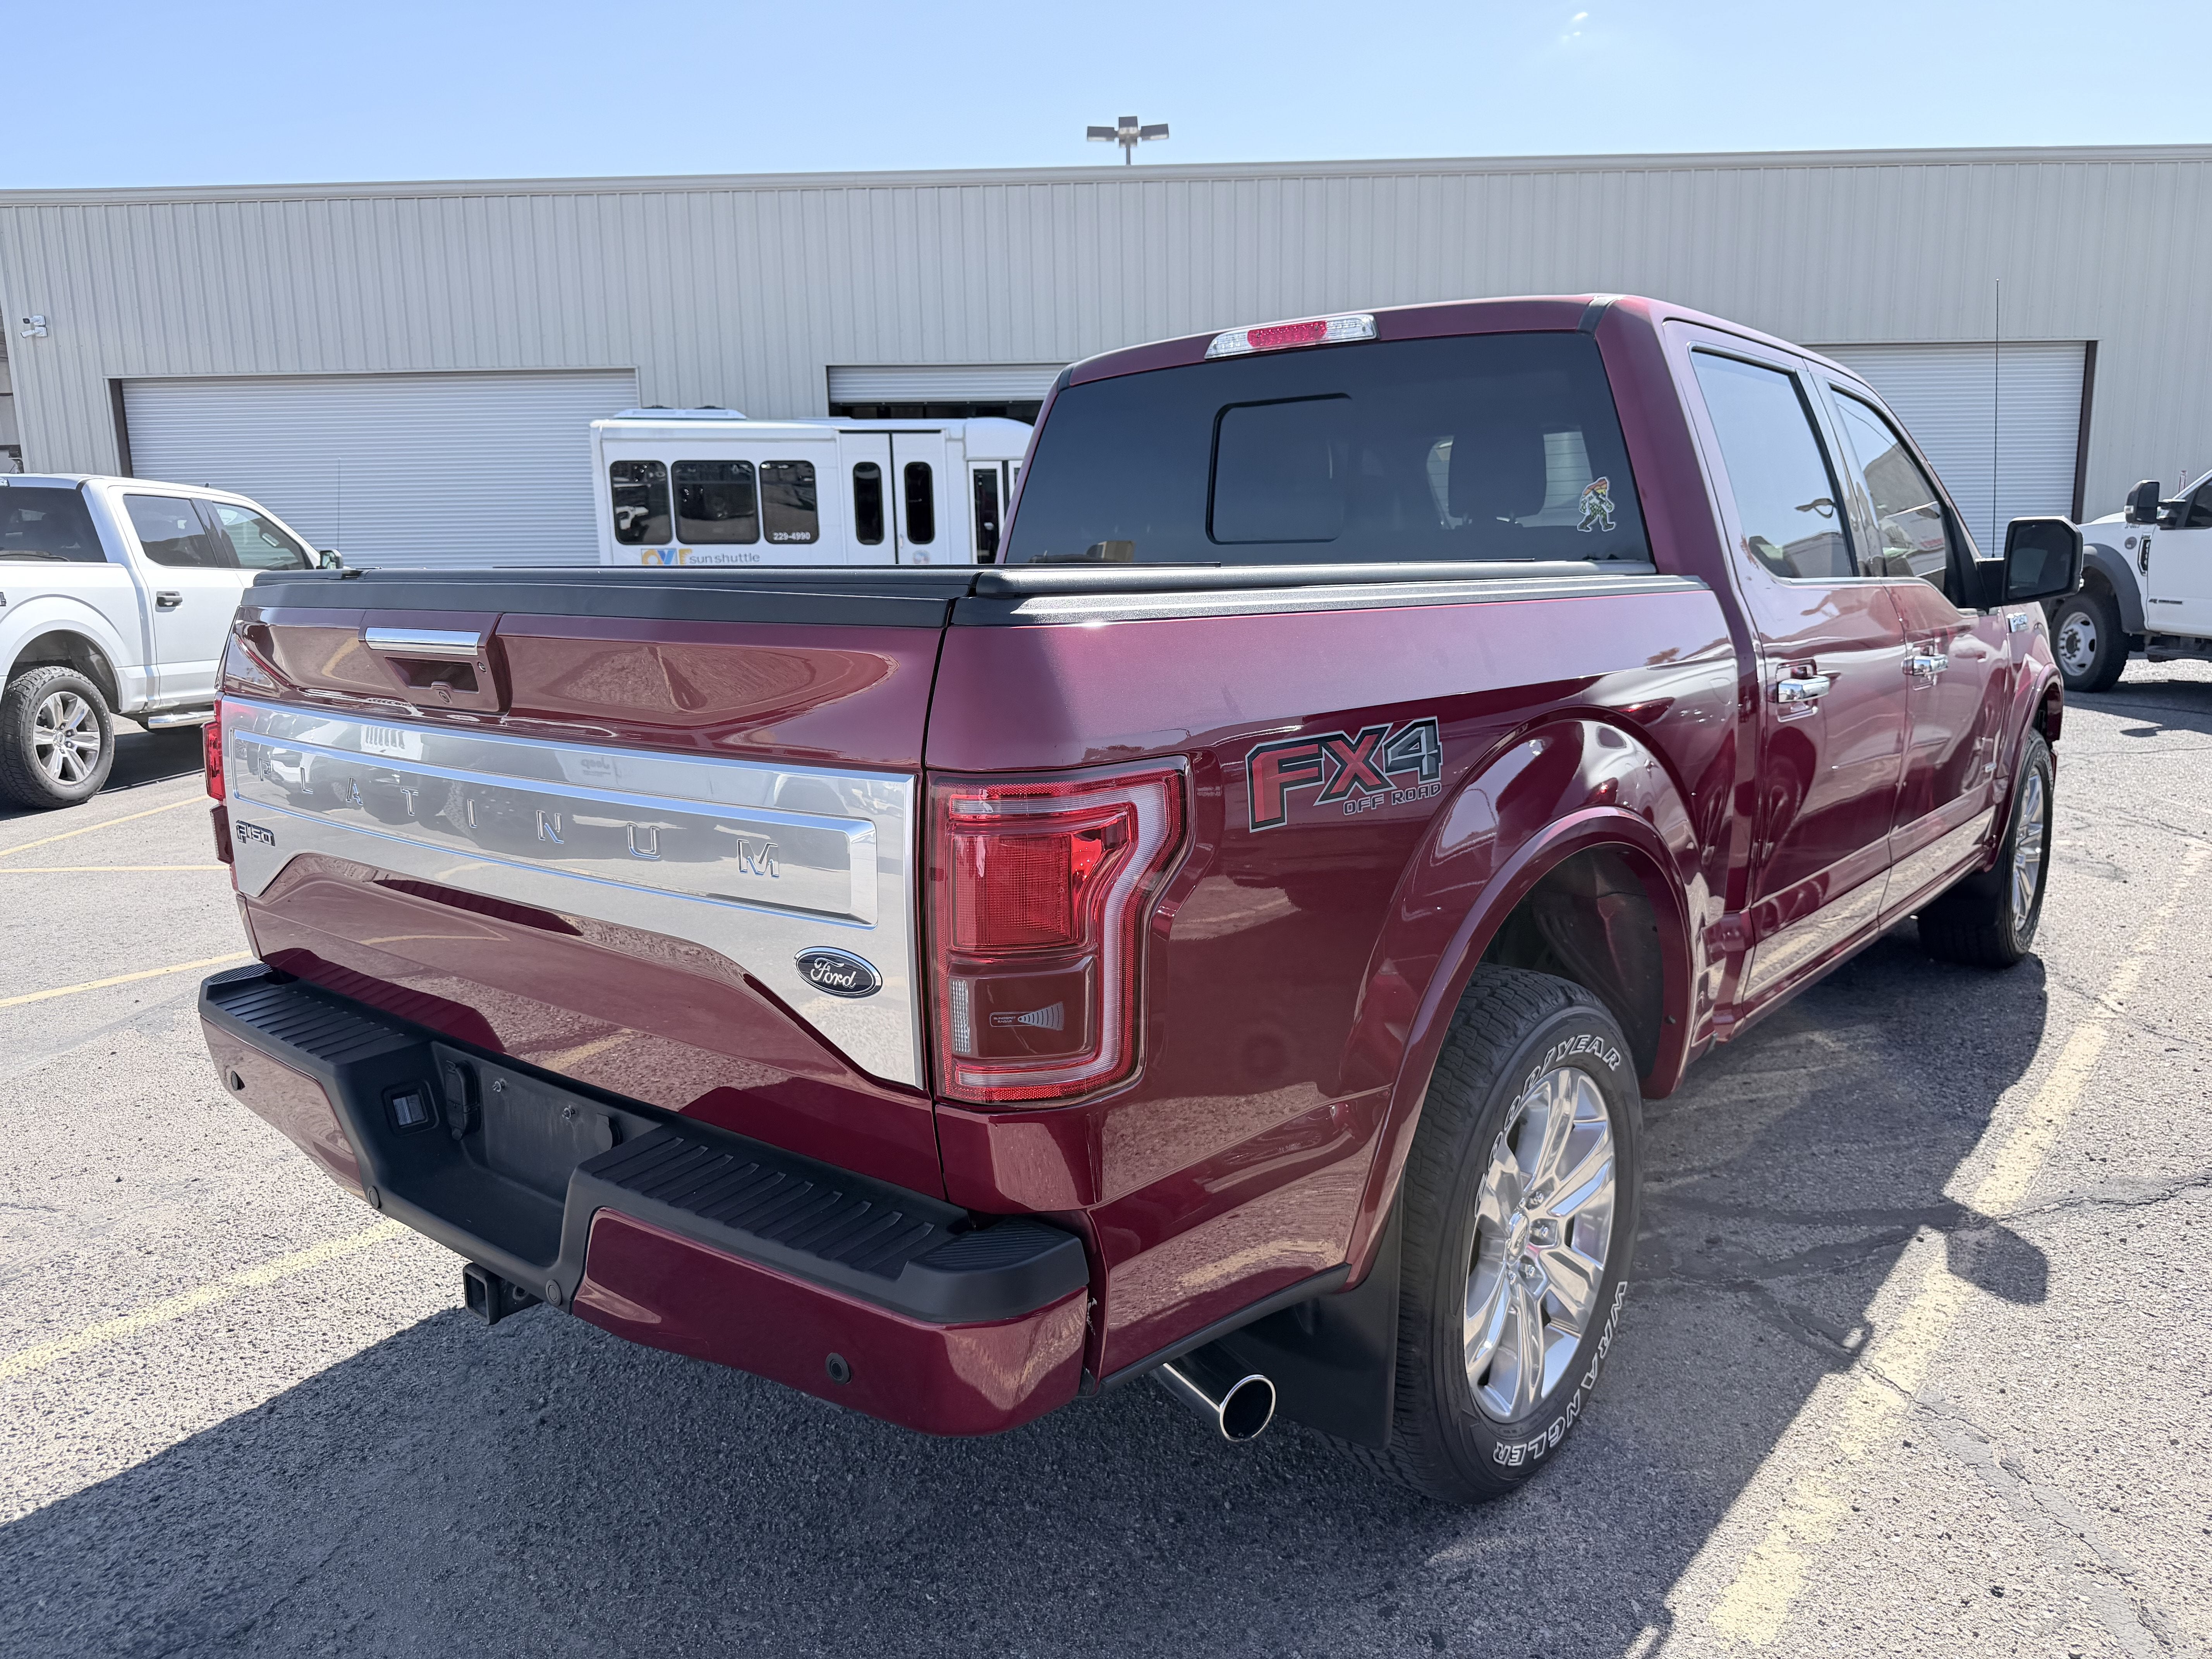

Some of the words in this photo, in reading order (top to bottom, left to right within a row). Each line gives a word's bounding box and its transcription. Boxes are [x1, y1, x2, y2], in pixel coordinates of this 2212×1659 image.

[259, 757, 780, 878] PLATINUM
[1245, 716, 1443, 833] FX4
[1343, 793, 1384, 815] OFF
[1391, 782, 1442, 805] ROAD
[811, 957, 857, 989] Ford
[1493, 1281, 1627, 1467] WRANGLER
